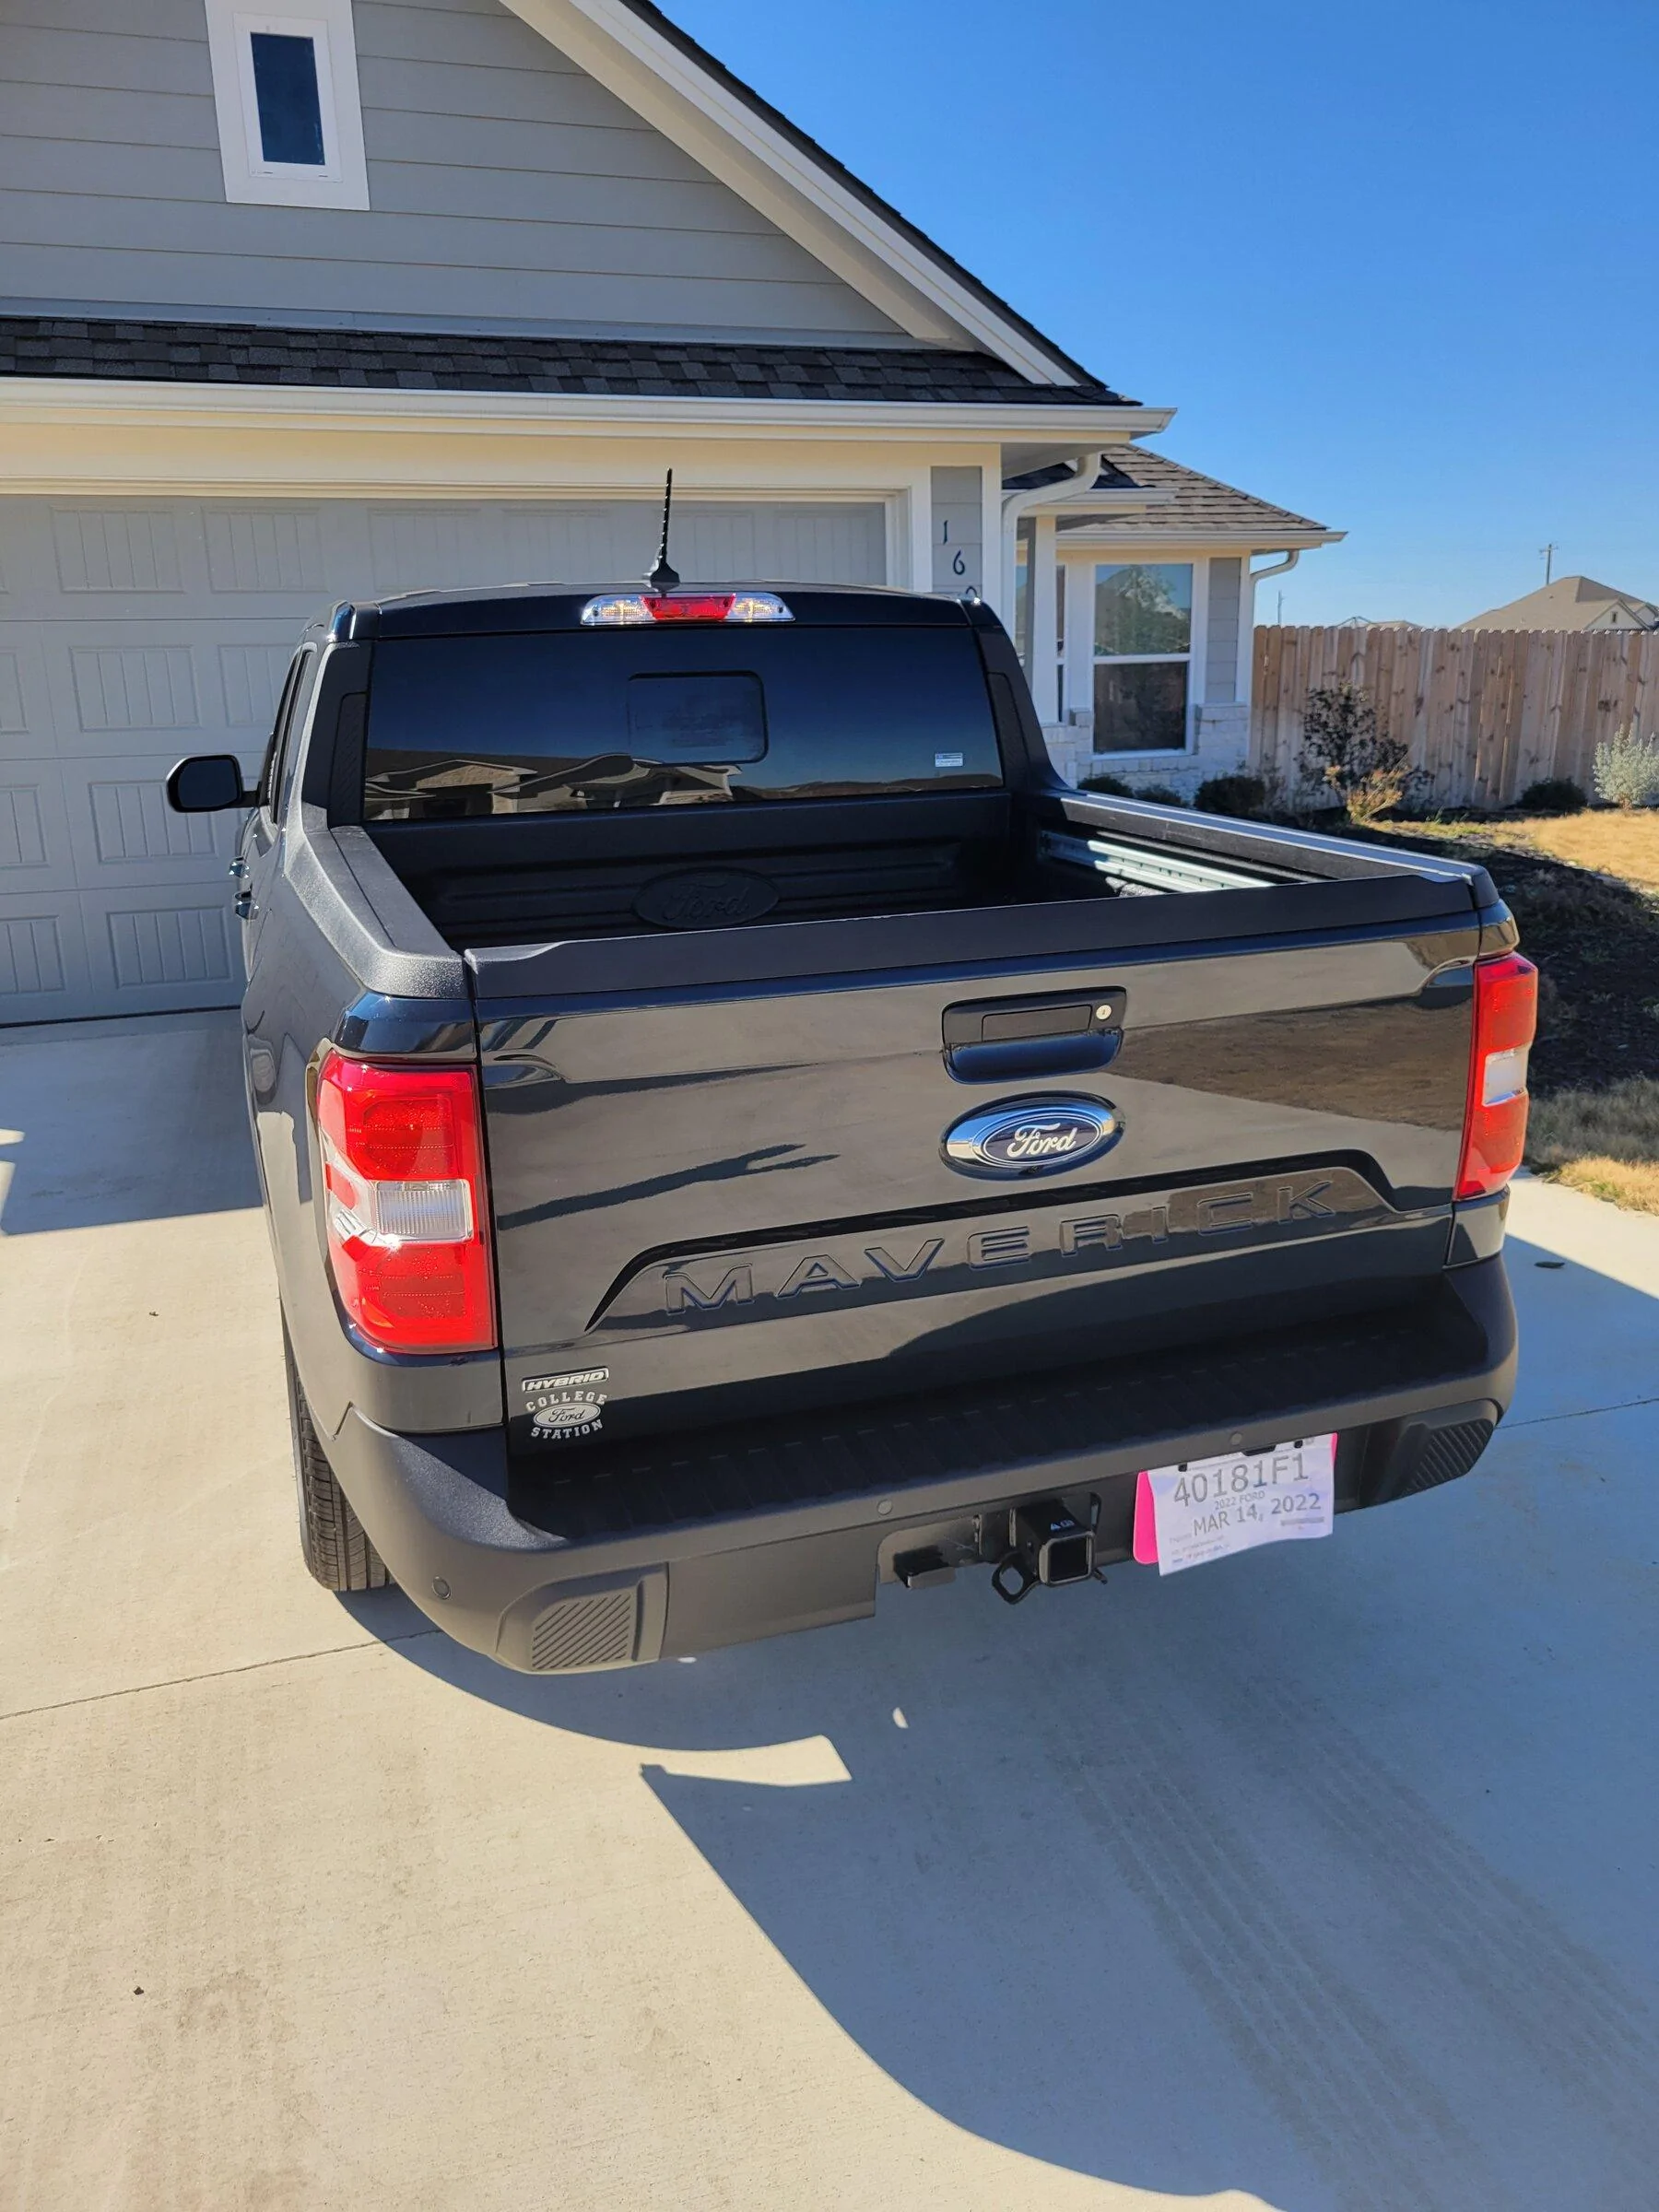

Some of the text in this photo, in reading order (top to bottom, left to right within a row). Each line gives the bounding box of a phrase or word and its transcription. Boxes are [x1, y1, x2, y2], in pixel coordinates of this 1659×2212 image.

[661, 877, 752, 922] Ford
[1006, 1122, 1078, 1158] Ford
[662, 1179, 1335, 1317] MAVERICK
[526, 1371, 605, 1391] HYBRID
[525, 1390, 607, 1412] COLLEGE
[547, 1407, 586, 1423] Ford
[530, 1419, 604, 1440] STATION
[1173, 1452, 1309, 1507] 40181F1
[1193, 1511, 1230, 1537] MAR
[1236, 1502, 1264, 1523] 14,
[1271, 1492, 1322, 1515] 2022
[1214, 1489, 1265, 1511] 2022 FORD
